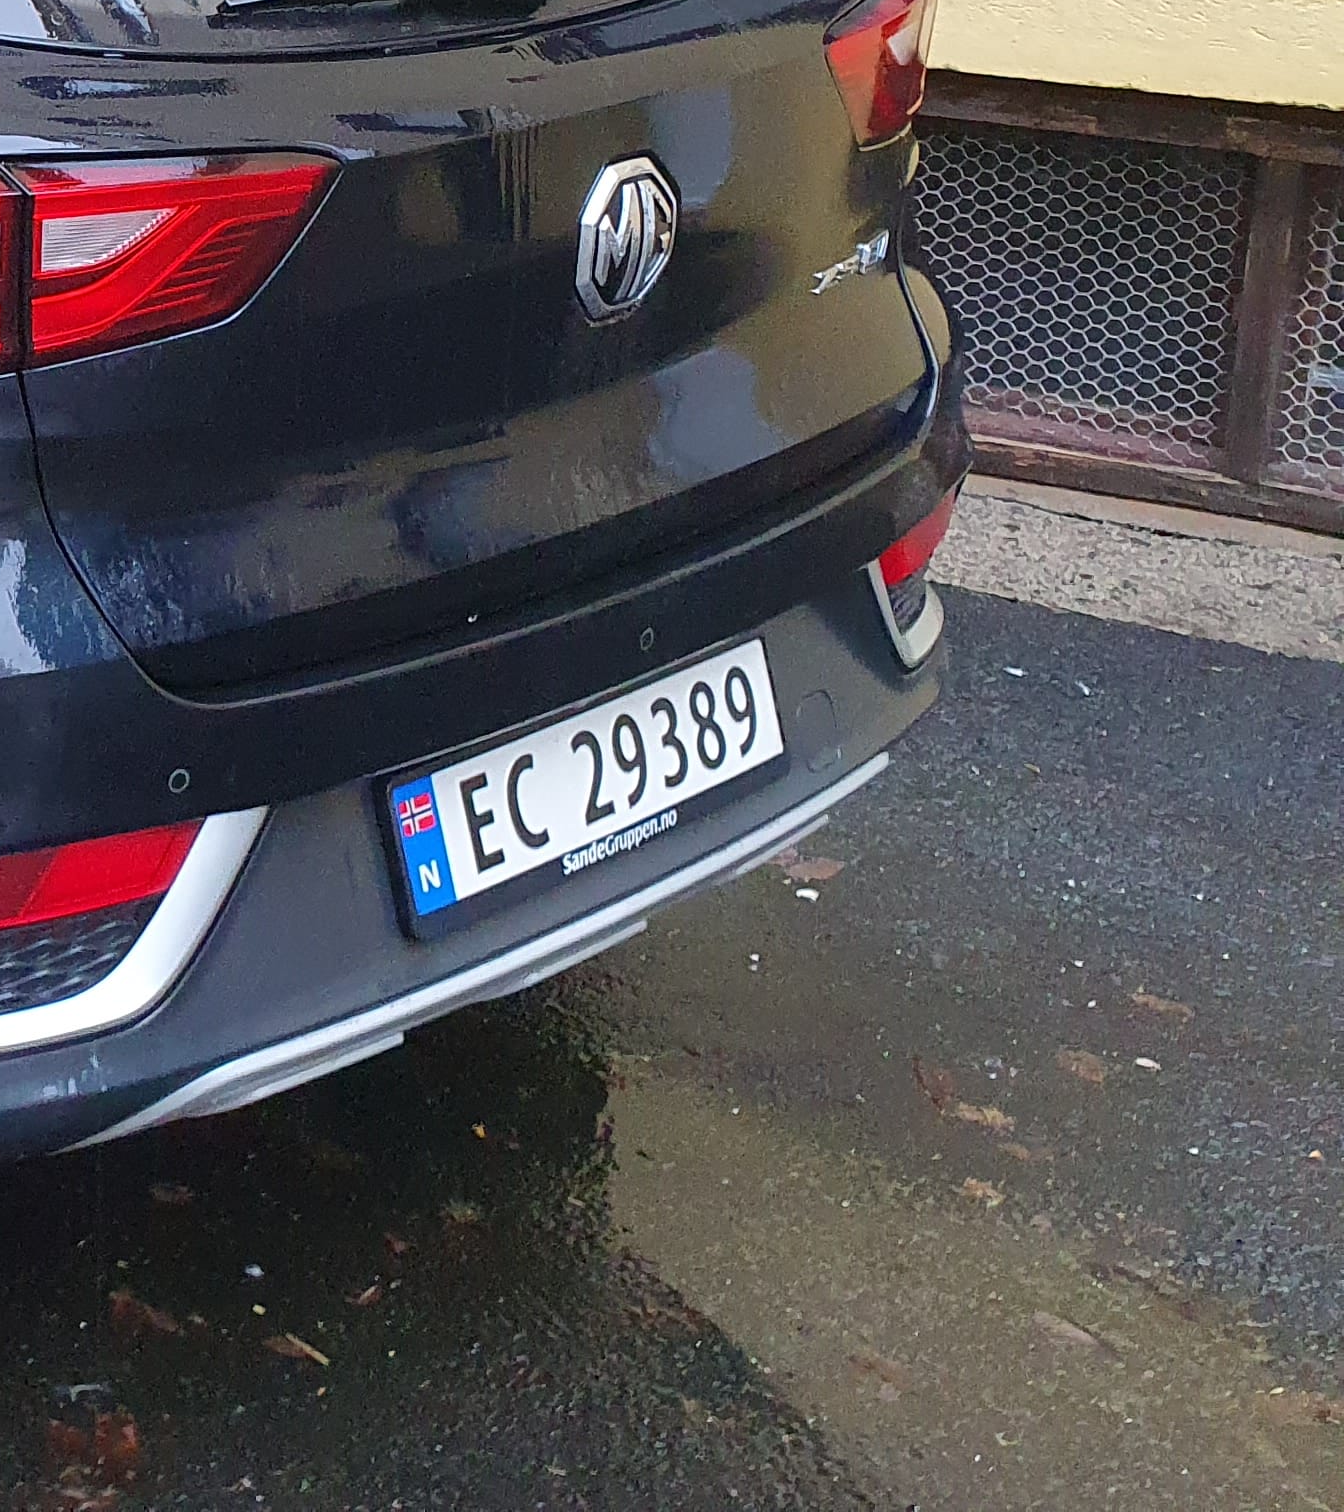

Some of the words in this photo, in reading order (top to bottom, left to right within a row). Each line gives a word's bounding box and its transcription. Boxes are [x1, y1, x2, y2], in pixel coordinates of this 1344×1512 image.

[593, 178, 675, 301] MG
[459, 752, 550, 874] EC
[570, 665, 758, 827] 29389
[418, 859, 441, 893] N
[562, 808, 678, 876] SandeGruppen.no
